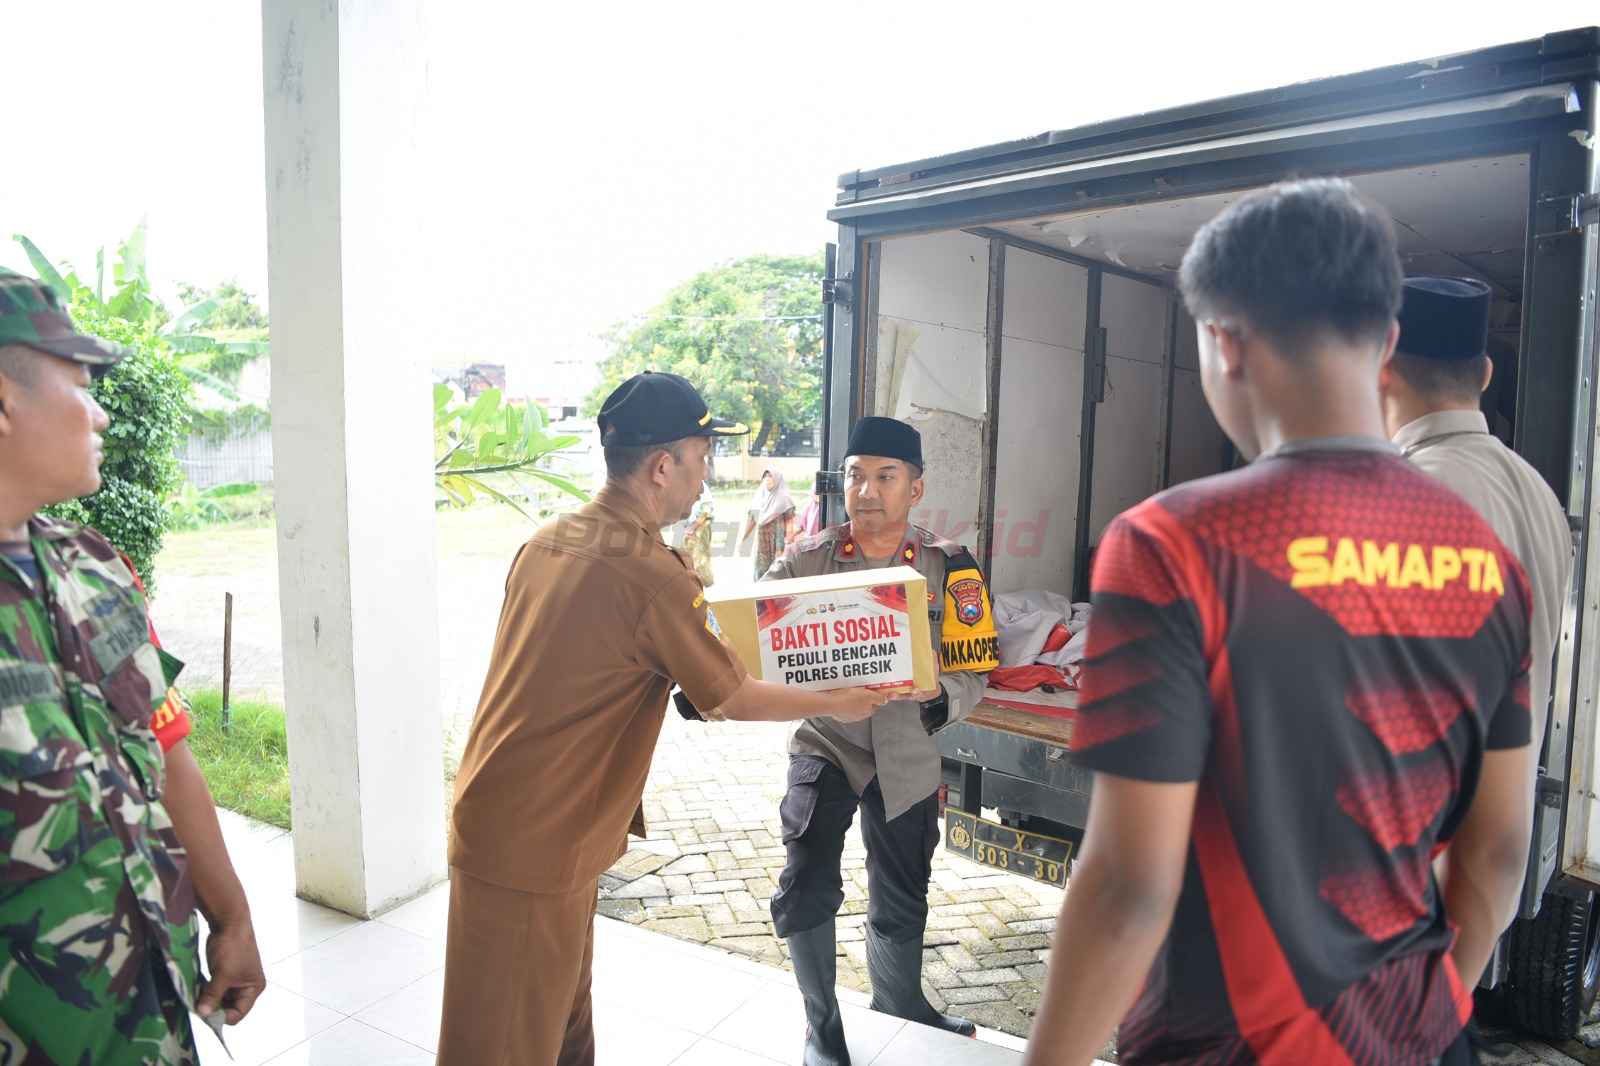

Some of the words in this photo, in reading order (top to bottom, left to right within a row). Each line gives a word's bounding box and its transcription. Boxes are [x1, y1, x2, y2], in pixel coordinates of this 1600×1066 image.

[1286, 536, 1505, 597] SAMAPTA
[770, 623, 829, 652] BAKTI
[834, 614, 901, 645] SOSIAL
[777, 652, 827, 669] PEDULI
[832, 642, 897, 662] BENCANA
[785, 666, 838, 684] POLRES
[843, 659, 893, 677] GRESIK
[1014, 833, 1026, 852] X
